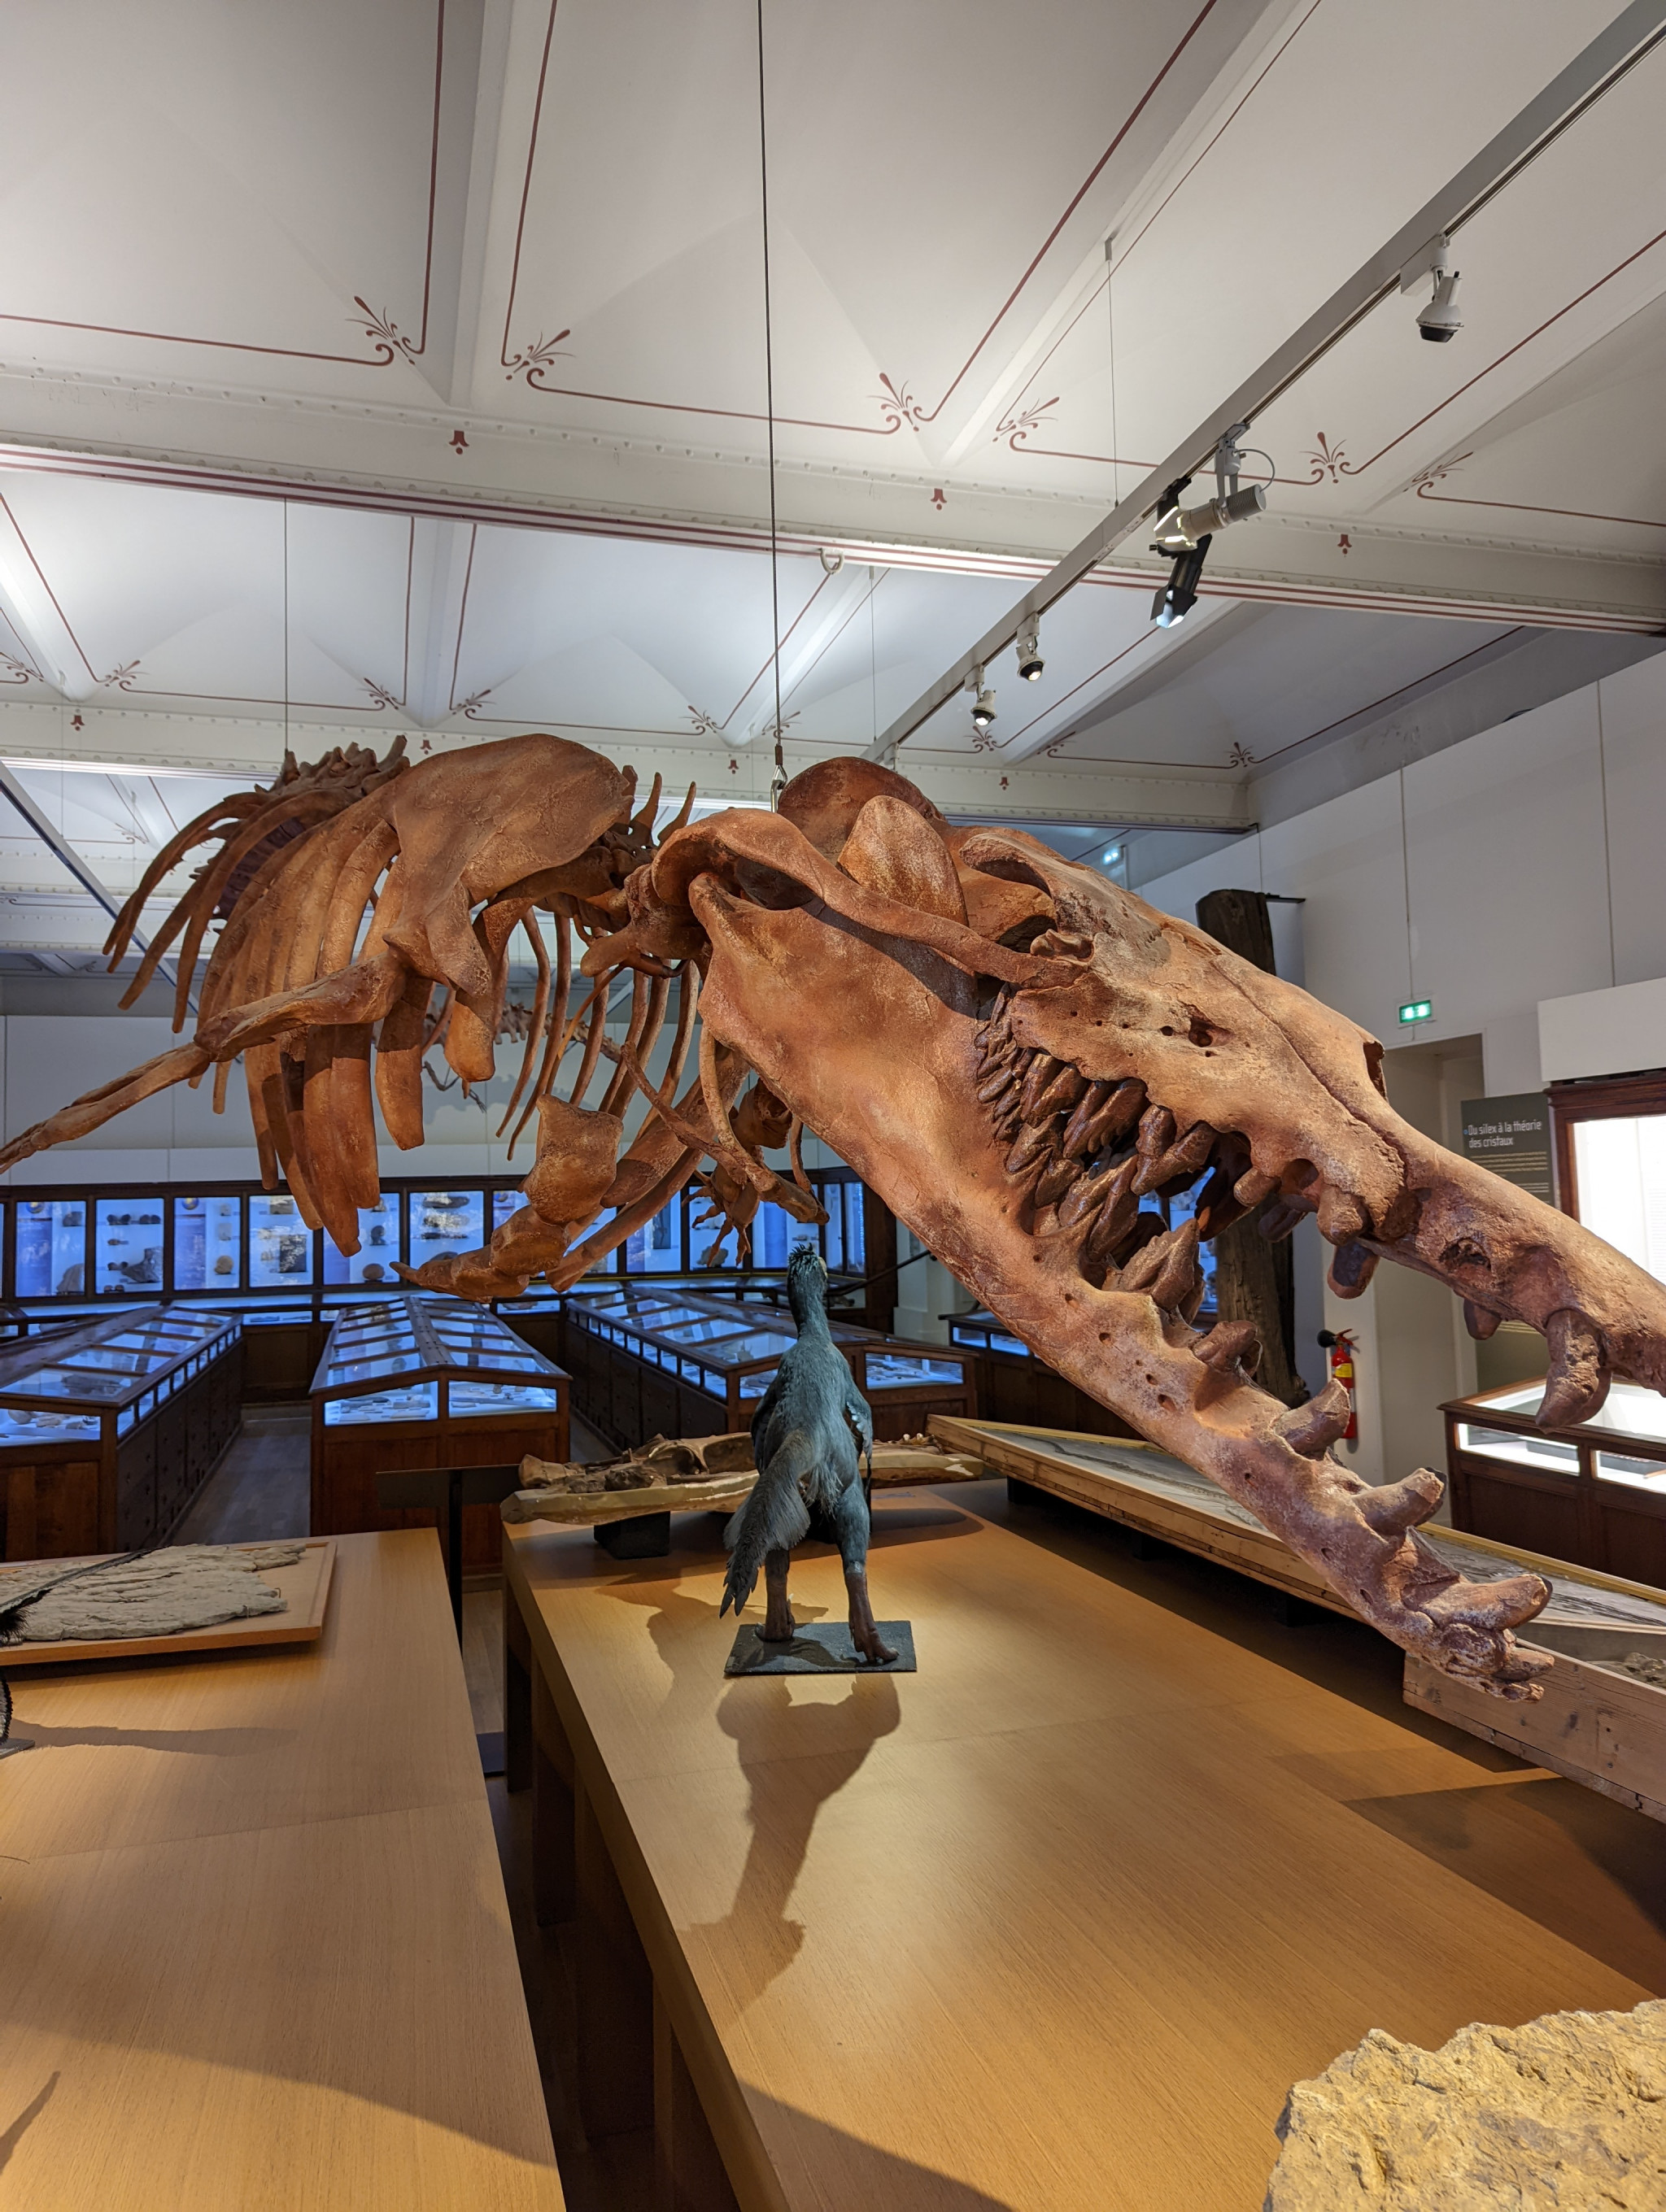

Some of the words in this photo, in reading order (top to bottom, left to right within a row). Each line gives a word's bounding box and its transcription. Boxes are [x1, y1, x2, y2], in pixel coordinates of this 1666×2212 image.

[1468, 1124, 1477, 1135] Du
[1479, 1123, 1497, 1134] silex
[1498, 1122, 1503, 1133] à
[1504, 1121, 1512, 1133] la
[1513, 1119, 1542, 1131] théorie
[1468, 1138, 1481, 1148] des
[1483, 1136, 1513, 1147] cristaux
